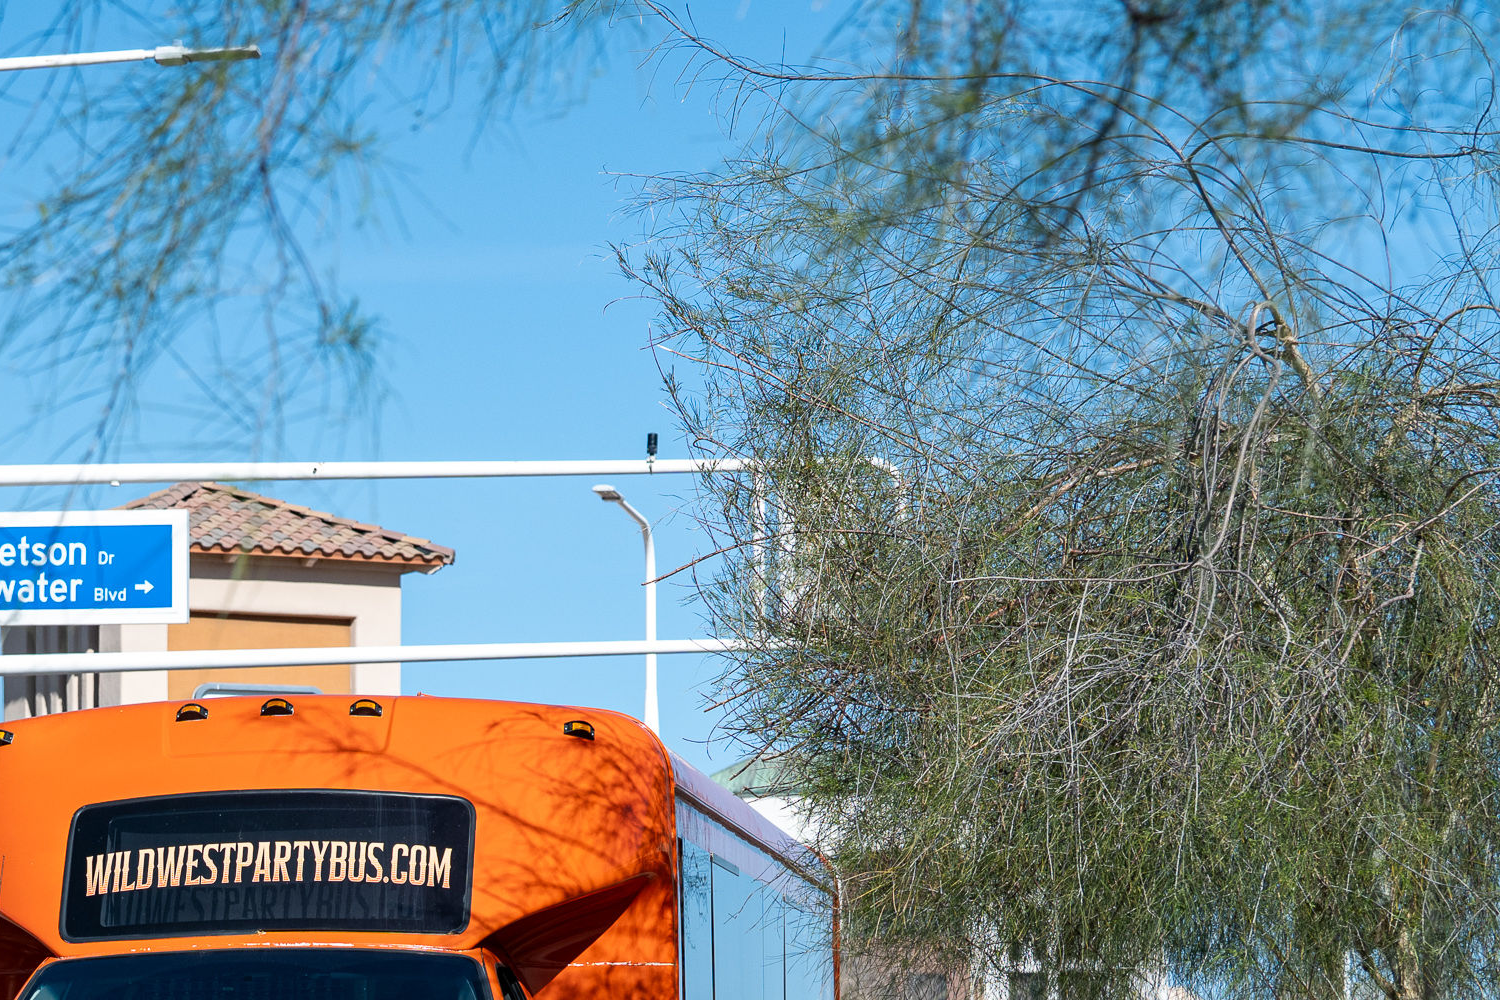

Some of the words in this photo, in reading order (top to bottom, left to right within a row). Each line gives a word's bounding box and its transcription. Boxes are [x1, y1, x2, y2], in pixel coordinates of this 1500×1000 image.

[97, 550, 116, 565] Dr
[93, 587, 128, 602] Blvd
[85, 840, 453, 897] WILDWESTPARTYBUS.COM
